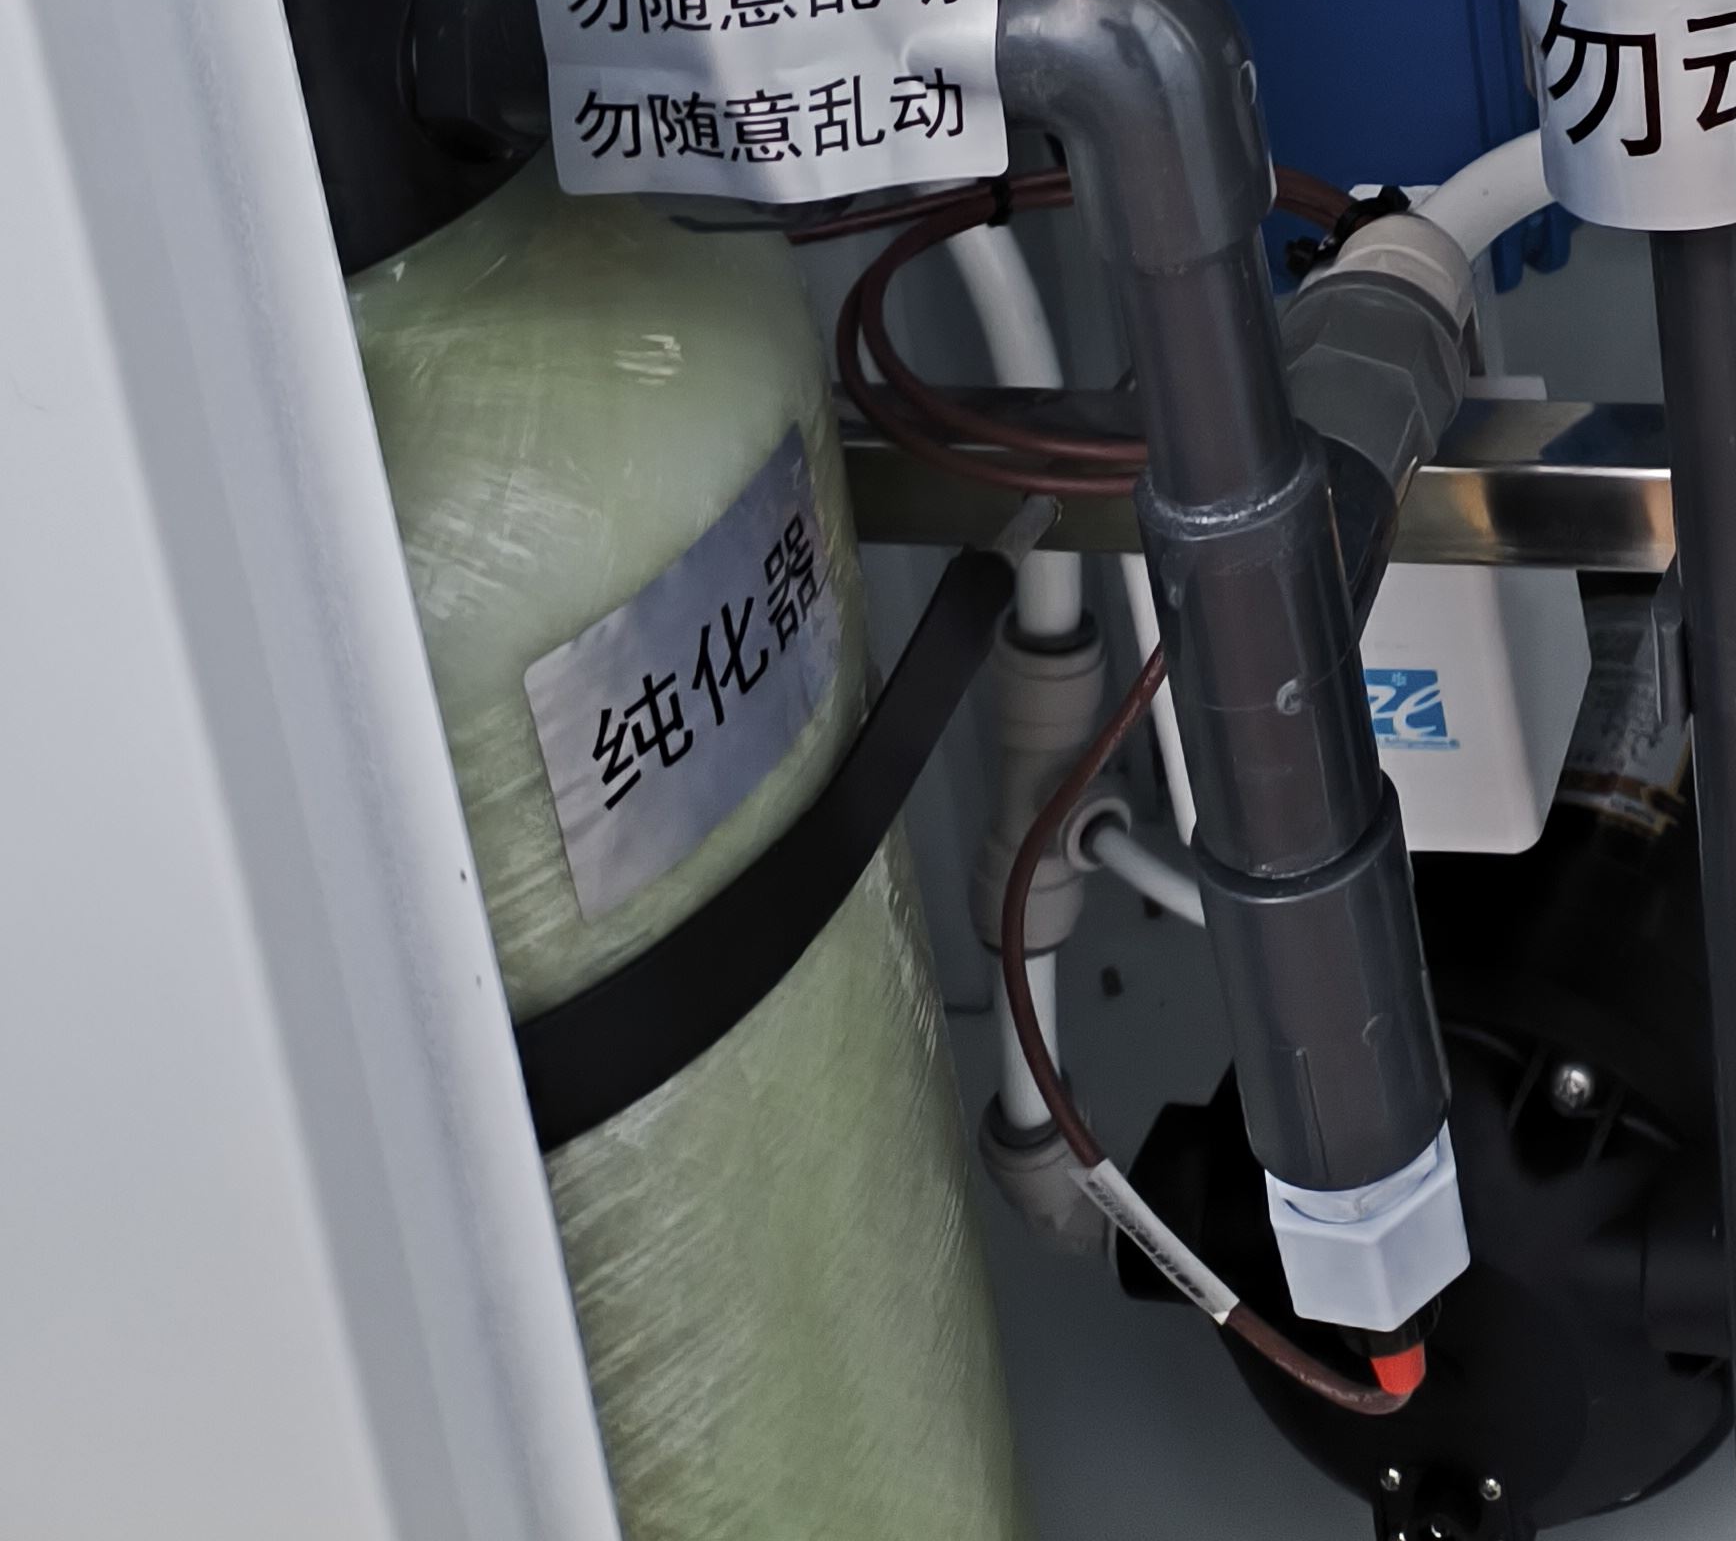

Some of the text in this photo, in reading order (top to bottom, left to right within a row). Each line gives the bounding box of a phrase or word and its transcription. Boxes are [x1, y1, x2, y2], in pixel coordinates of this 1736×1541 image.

[574, 67, 966, 164] 勿随意乱动
[592, 511, 820, 811] 纯化器
